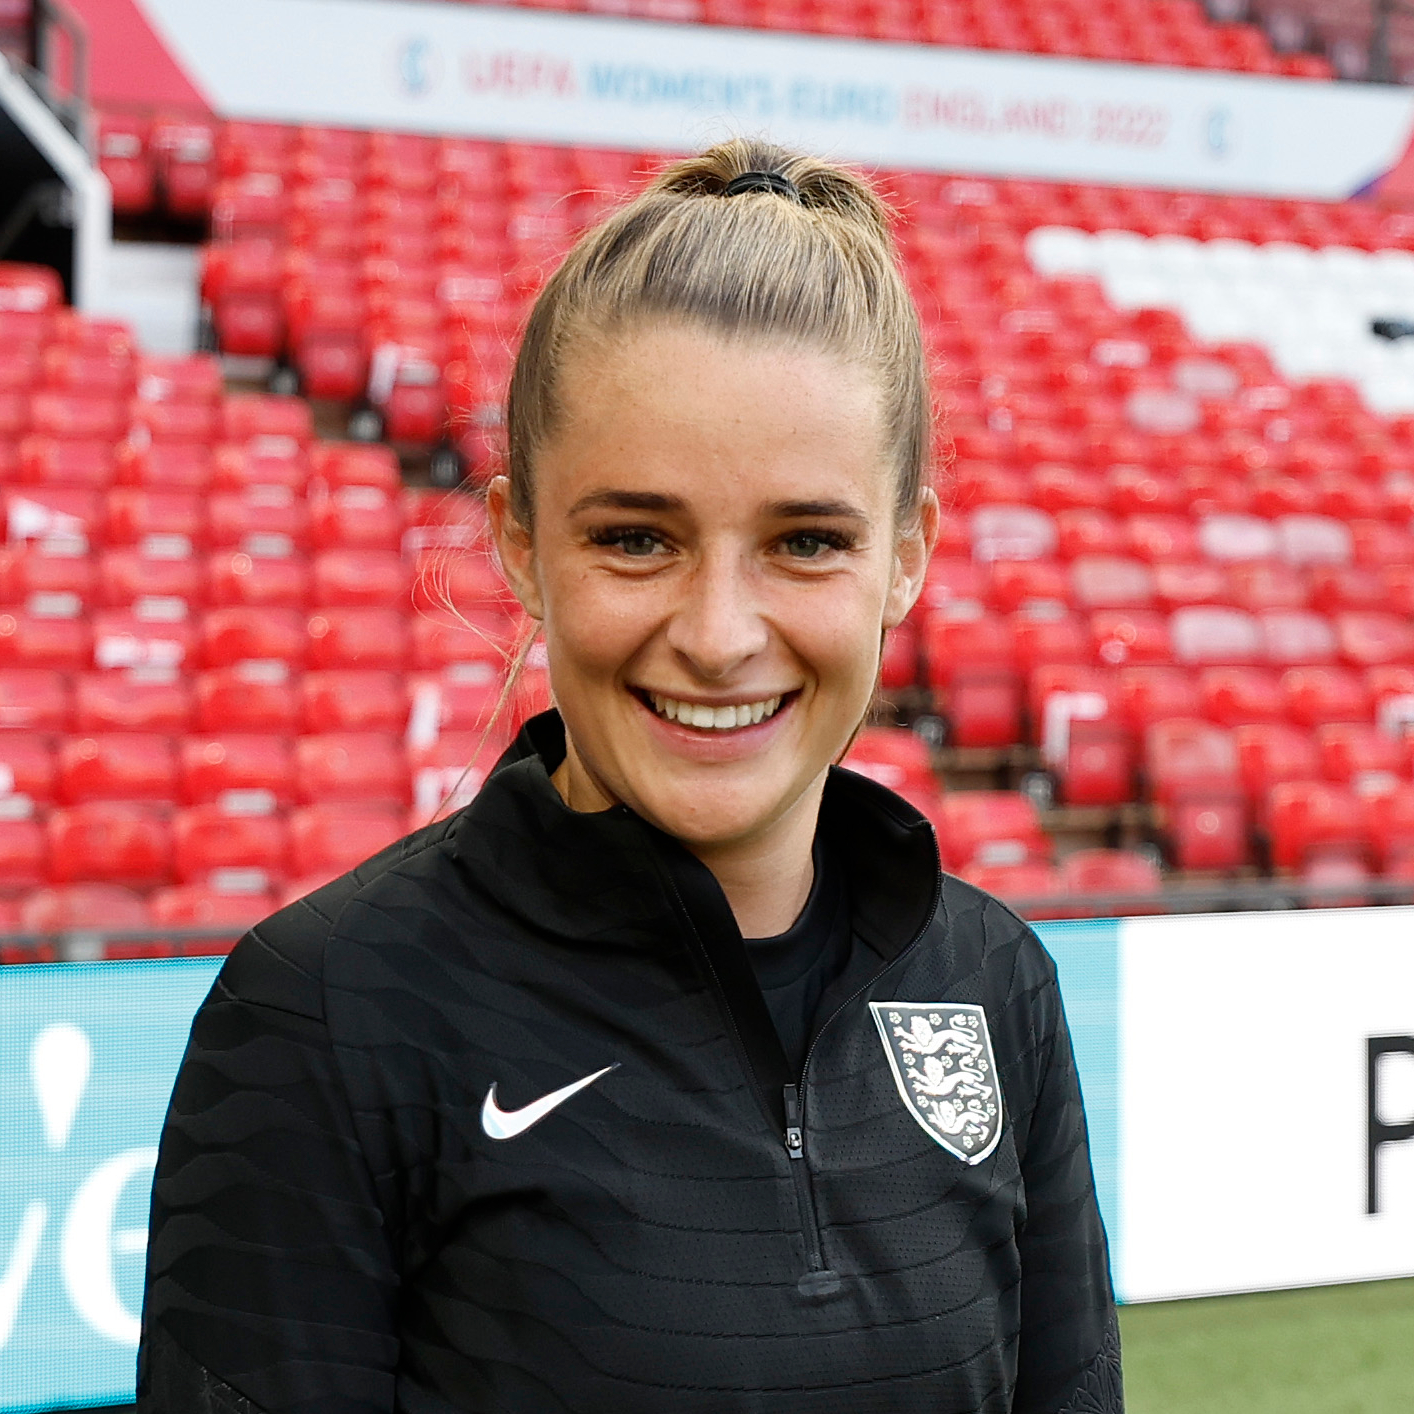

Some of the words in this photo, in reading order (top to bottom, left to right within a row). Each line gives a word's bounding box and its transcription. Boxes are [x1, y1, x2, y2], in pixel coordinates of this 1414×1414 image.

[459, 49, 577, 99] UEFA
[787, 77, 895, 123] EURO
[900, 85, 1080, 140] ENGLAND
[1089, 103, 1172, 148] 2022
